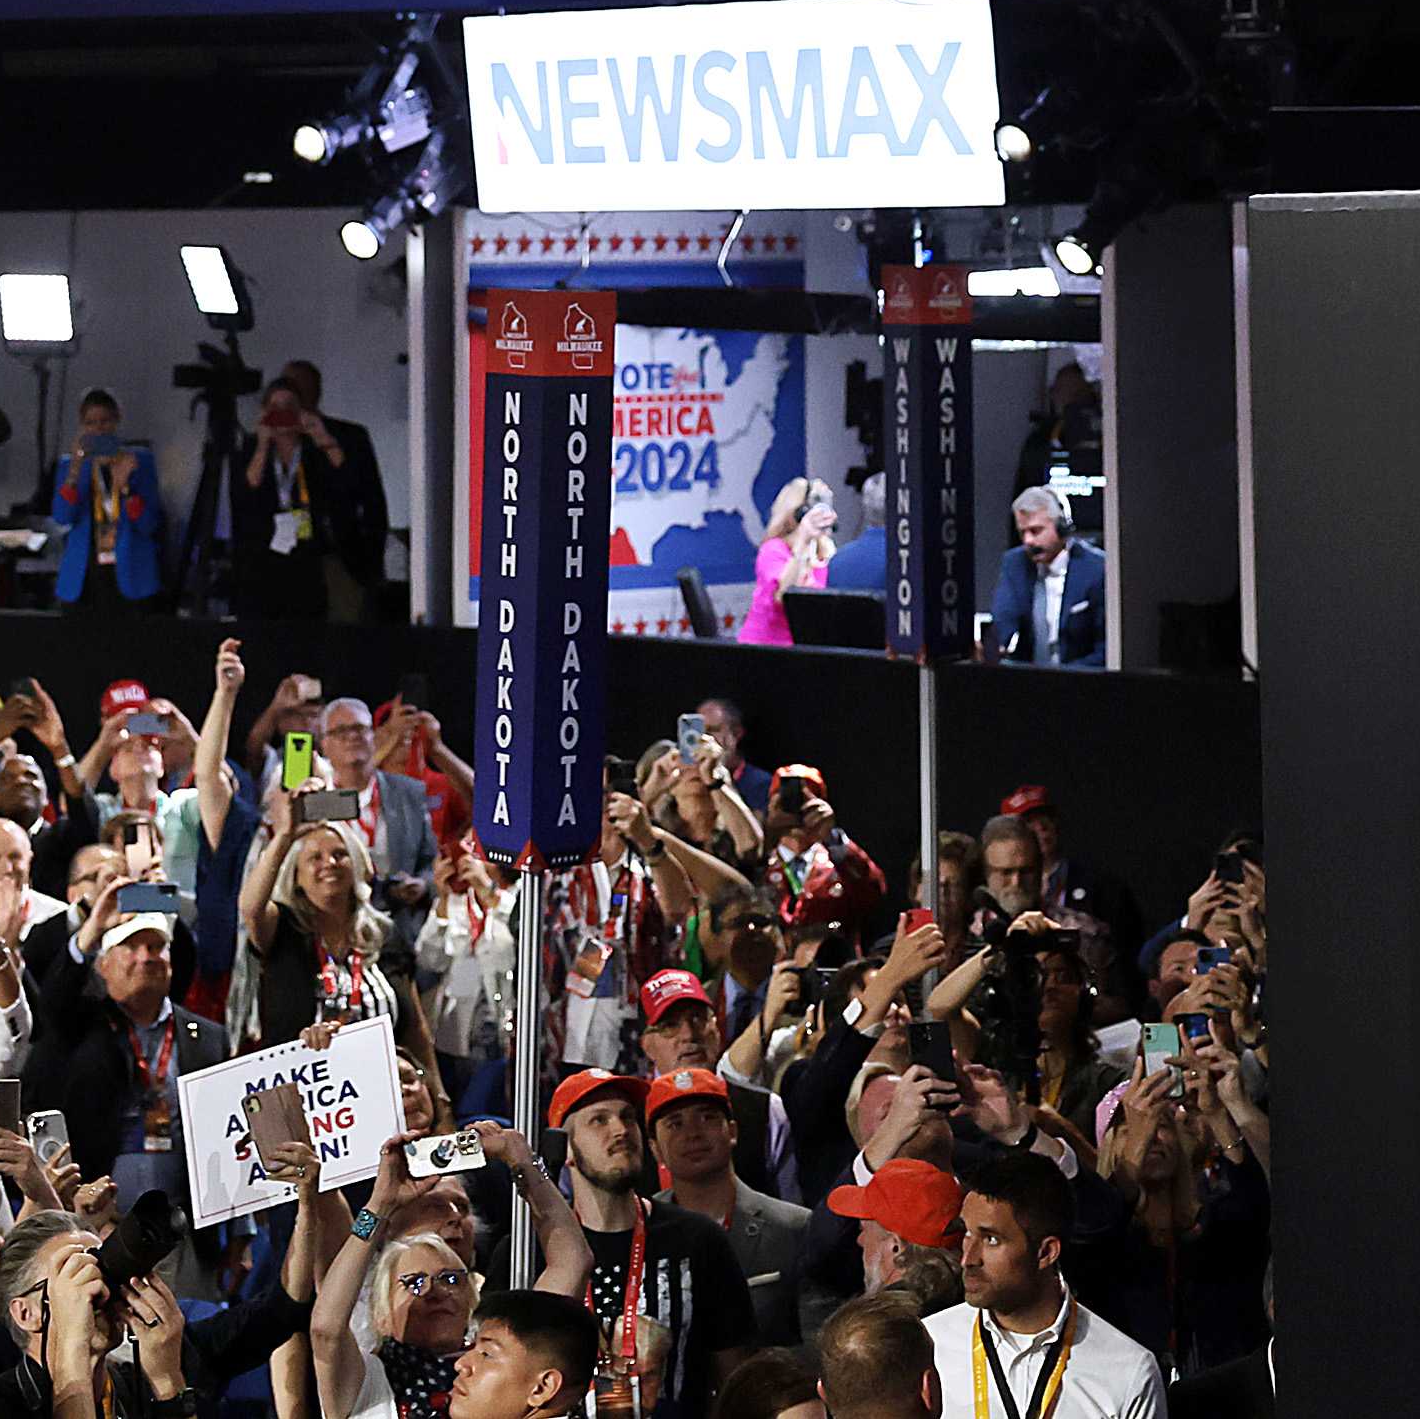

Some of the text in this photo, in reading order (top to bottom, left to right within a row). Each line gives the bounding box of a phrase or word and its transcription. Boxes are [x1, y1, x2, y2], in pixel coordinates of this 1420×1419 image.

[491, 42, 974, 164] NEWSMAX
[621, 364, 672, 389] OTE
[615, 440, 721, 492] 2024
[893, 339, 912, 636] WASHINGTON
[936, 338, 958, 636] WASHINGTON
[493, 391, 521, 826] NORTH DAKOTA
[558, 393, 588, 827] NORTH DAKOTA
[226, 1080, 359, 1137] AICA
[235, 1107, 354, 1161] SNG
[248, 1135, 349, 1186] AN!
